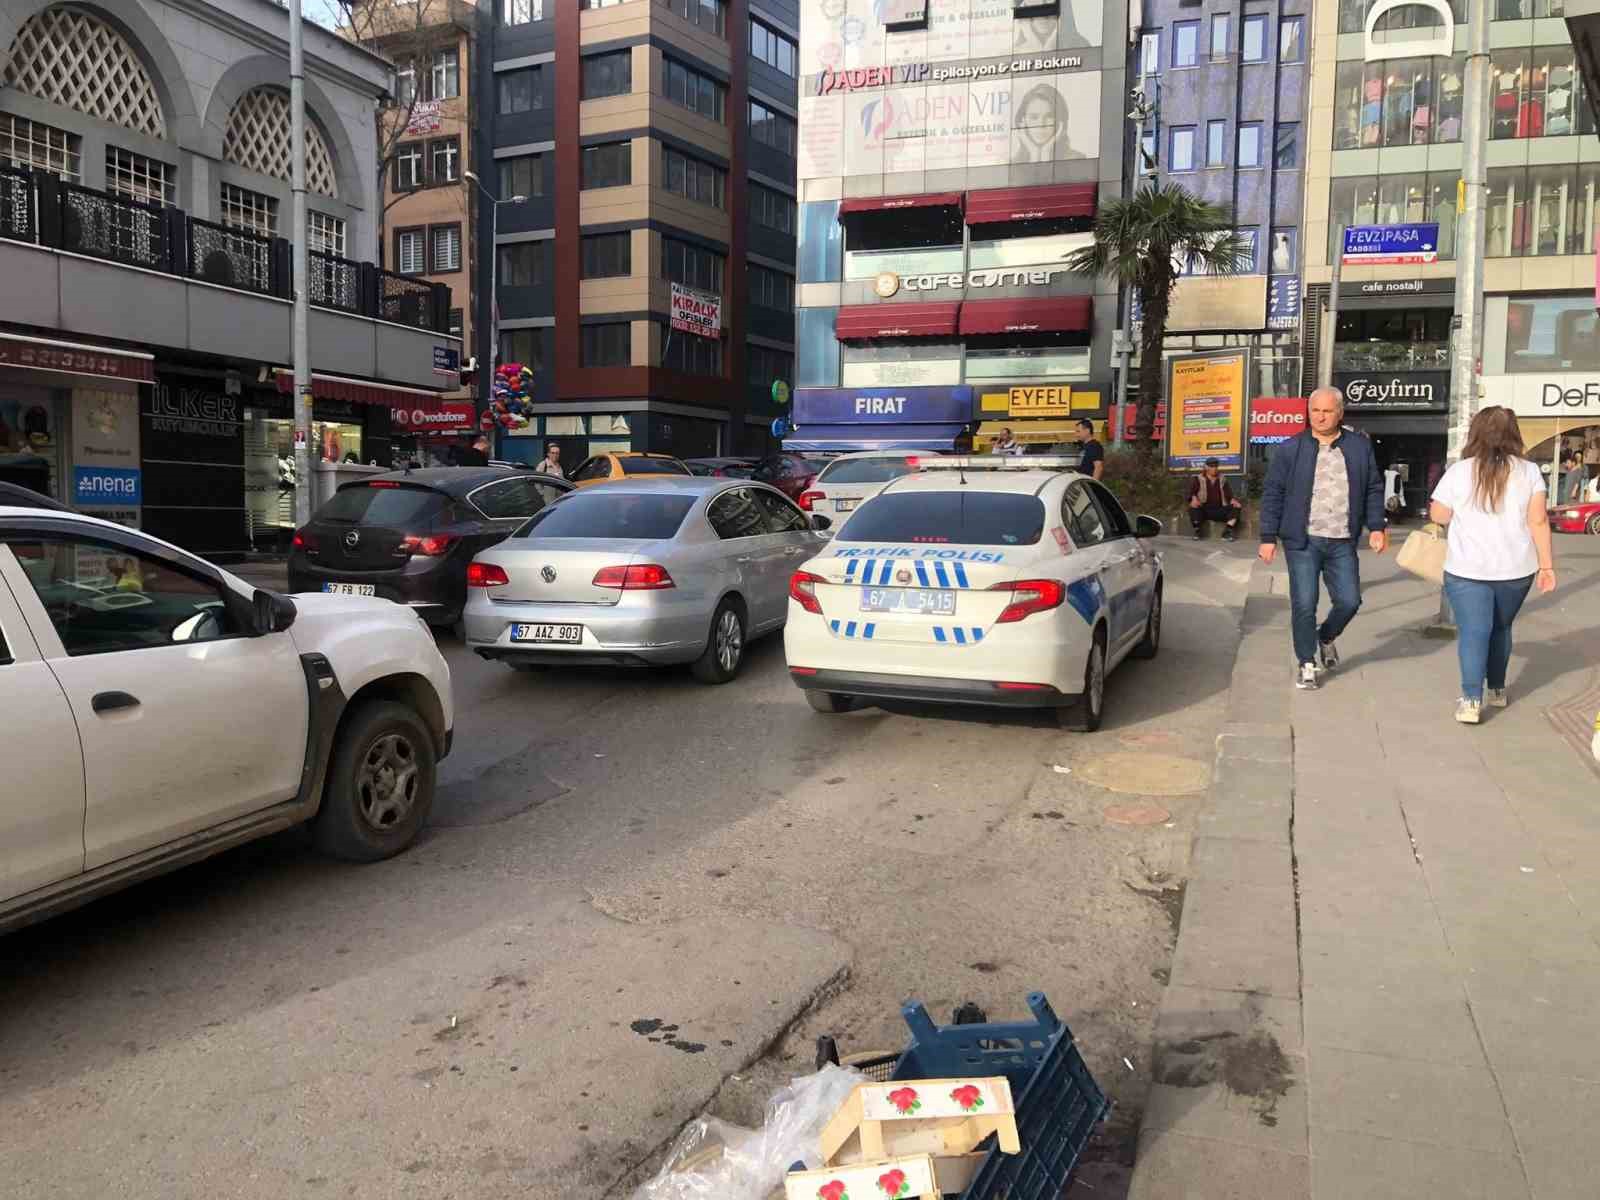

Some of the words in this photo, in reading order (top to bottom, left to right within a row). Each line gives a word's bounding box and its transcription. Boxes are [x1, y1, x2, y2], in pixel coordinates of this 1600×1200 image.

[835, 65, 893, 89] ADEN
[901, 63, 929, 84] VIP
[998, 63, 1009, 74] &
[894, 97, 962, 126] ADEN
[972, 91, 1010, 116] VIP
[1361, 281, 1384, 292] cafe
[1386, 280, 1423, 292] nostalji
[1011, 389, 1067, 405] EYFEL
[1542, 383, 1600, 407] DeF
[855, 397, 907, 414] FIRAT
[1250, 410, 1305, 424] dafone
[93, 476, 136, 493] nena
[833, 547, 915, 558] TRAFİK
[870, 590, 886, 606] 67
[919, 592, 953, 609] 5415
[517, 626, 530, 638] 67
[535, 626, 555, 639] AAZ
[559, 626, 579, 640] 903
